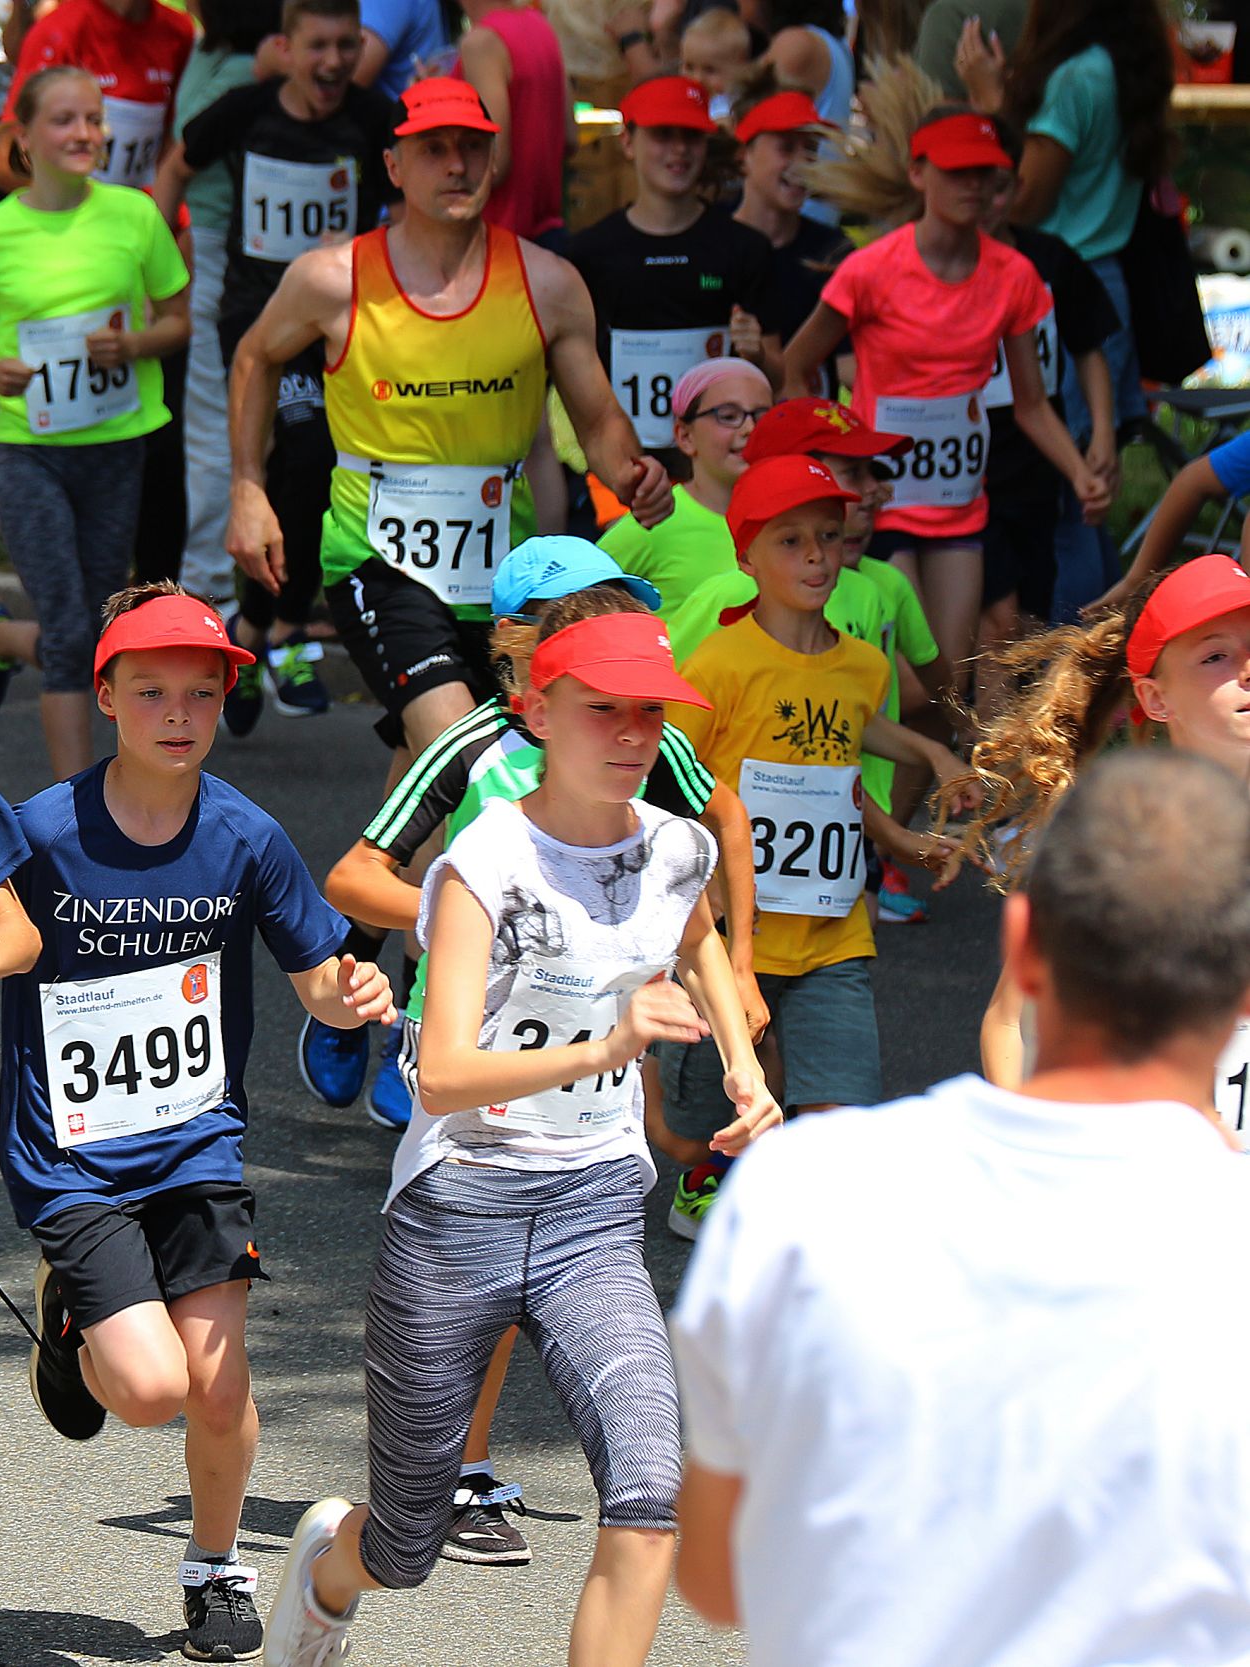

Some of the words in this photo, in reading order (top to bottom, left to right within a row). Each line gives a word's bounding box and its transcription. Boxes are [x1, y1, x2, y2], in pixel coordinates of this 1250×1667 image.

[254, 197, 348, 237] 1105
[395, 377, 516, 397] WERMA
[621, 374, 672, 418] 18
[378, 516, 495, 570] 3371
[753, 770, 806, 787] Stadtlauf
[749, 816, 862, 881] 3207
[53, 889, 242, 925] ZINZENDORF
[76, 928, 215, 957] SCHULEN
[533, 967, 595, 988] Stadtlauf
[55, 988, 115, 1006] Stadtlauf
[56, 993, 163, 1016] www.laufend-mithelfen.de
[60, 1014, 212, 1104] 3499
